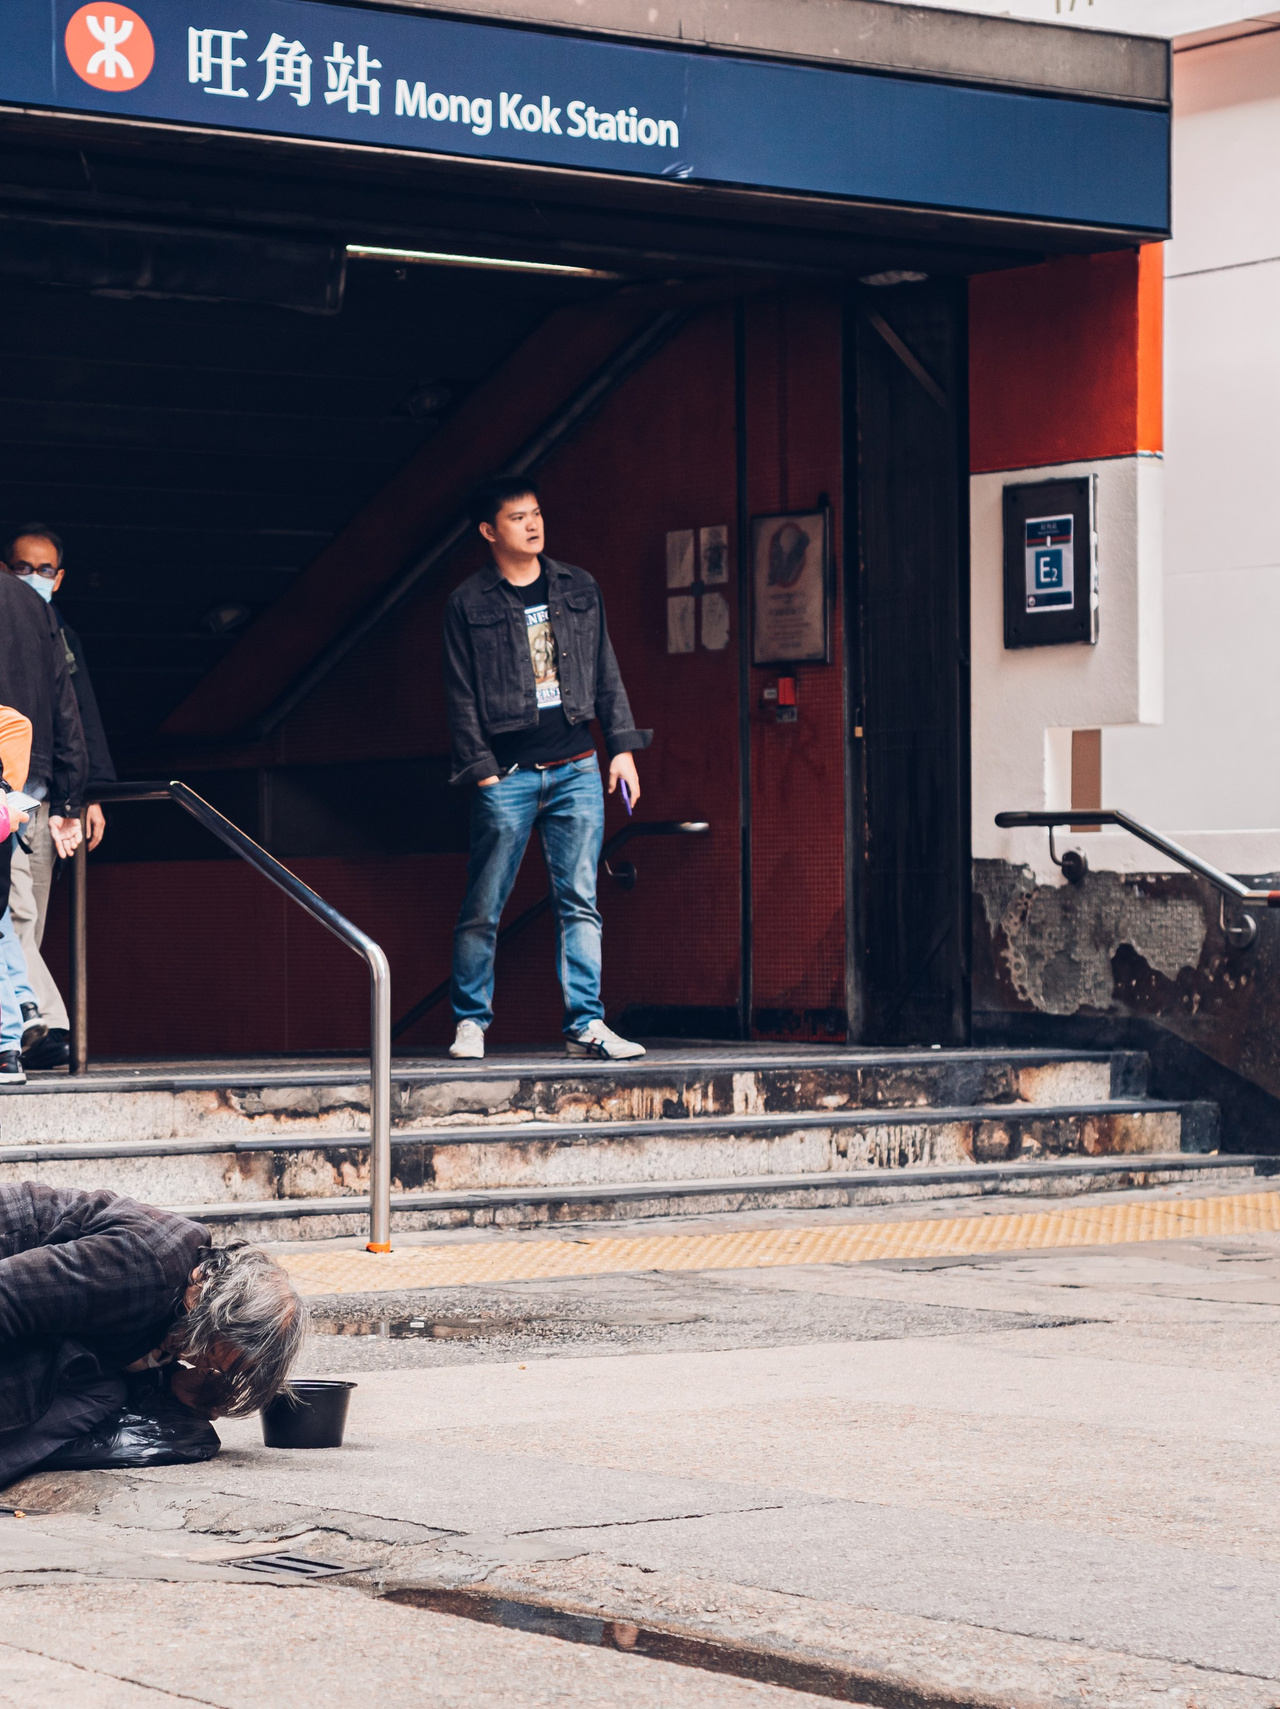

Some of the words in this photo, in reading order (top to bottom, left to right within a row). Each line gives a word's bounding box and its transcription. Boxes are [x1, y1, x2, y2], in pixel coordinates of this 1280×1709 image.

[188, 26, 382, 115] 旺角站
[395, 79, 493, 136] Mong
[499, 91, 563, 135] Kok
[566, 100, 679, 148] Station
